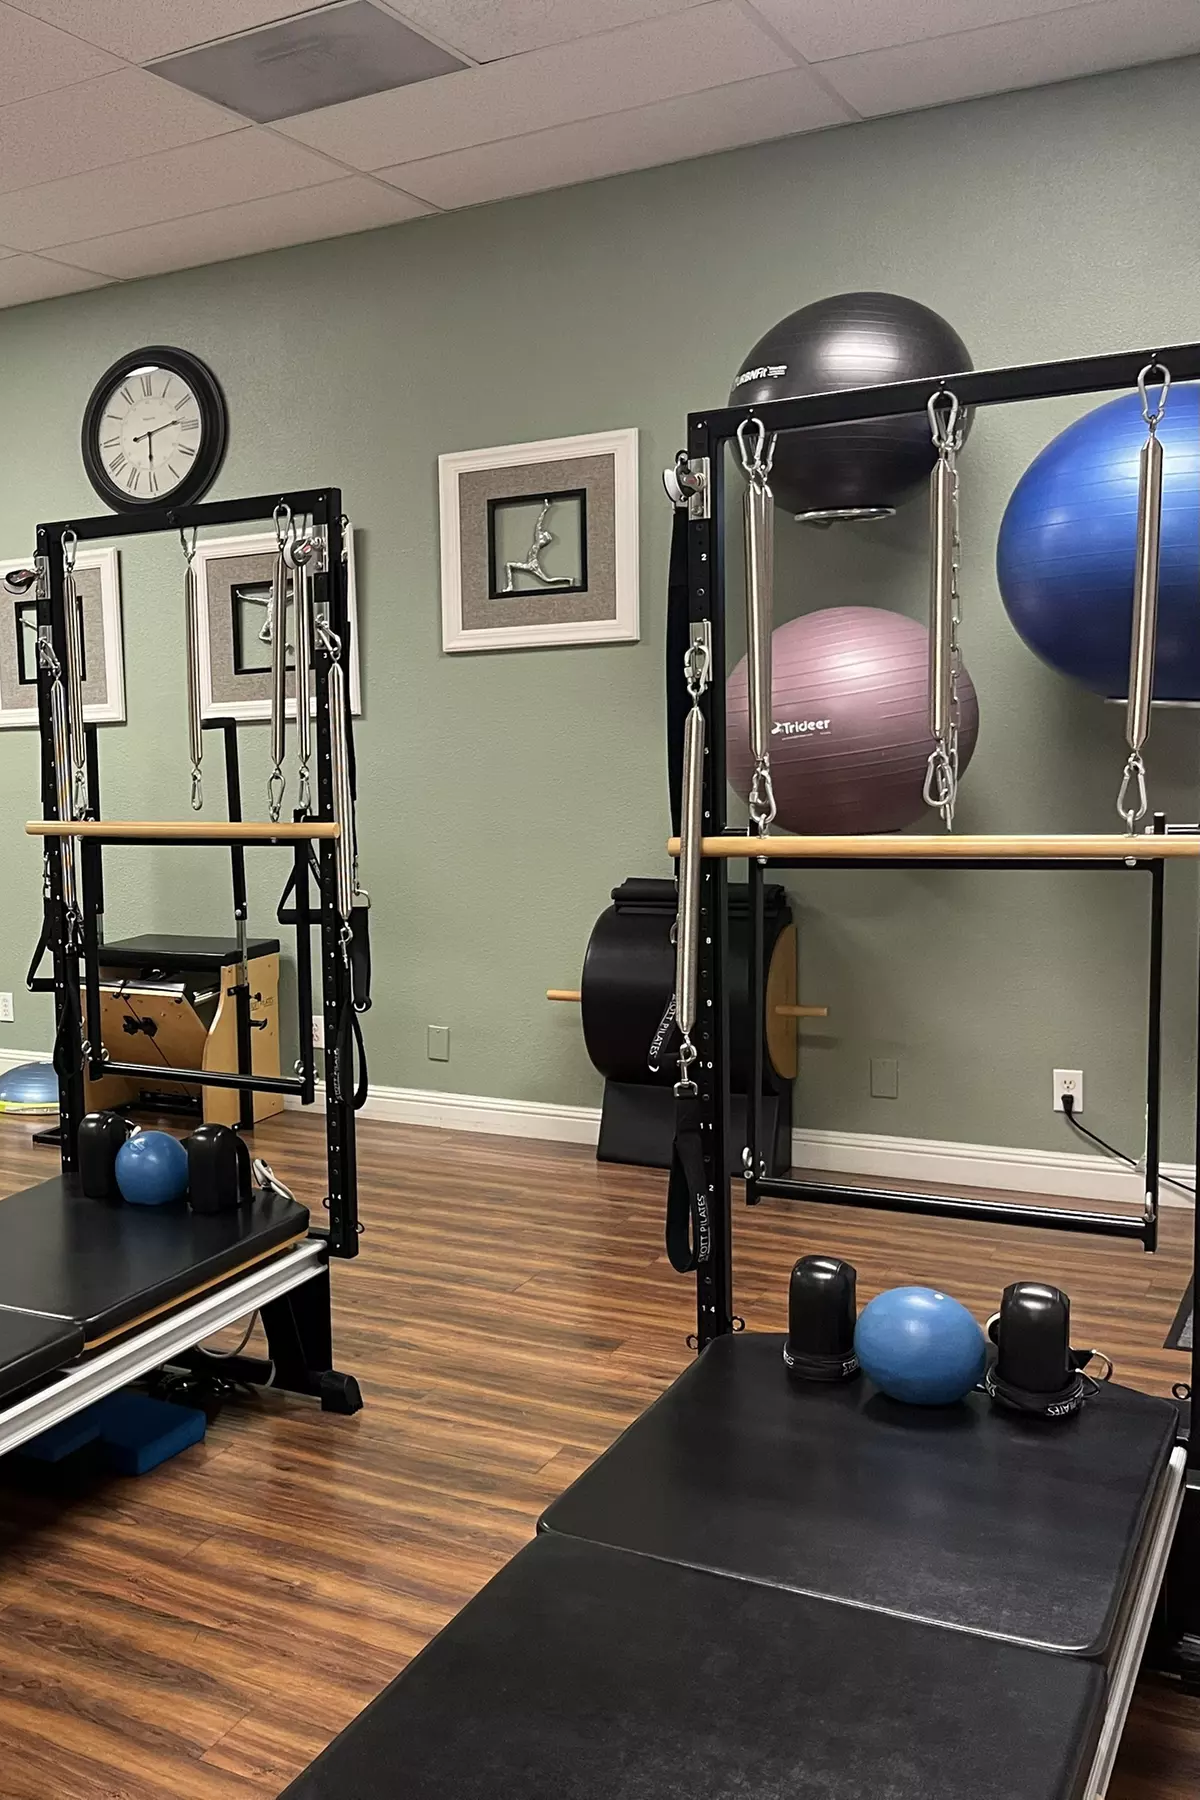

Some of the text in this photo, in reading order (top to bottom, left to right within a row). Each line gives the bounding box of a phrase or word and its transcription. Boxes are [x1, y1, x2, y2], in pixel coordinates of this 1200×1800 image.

[701, 553, 707, 561] 2
[782, 719, 831, 735] Trideer
[704, 810, 710, 818] 6
[705, 873, 711, 882] 7
[706, 936, 712, 944] 8
[706, 999, 712, 1007] 9
[649, 1021, 669, 1058] PILATES
[699, 1061, 713, 1069] 10
[699, 1122, 713, 1130] 11
[698, 1193, 709, 1233] PILATES
[701, 1304, 716, 1314] 14
